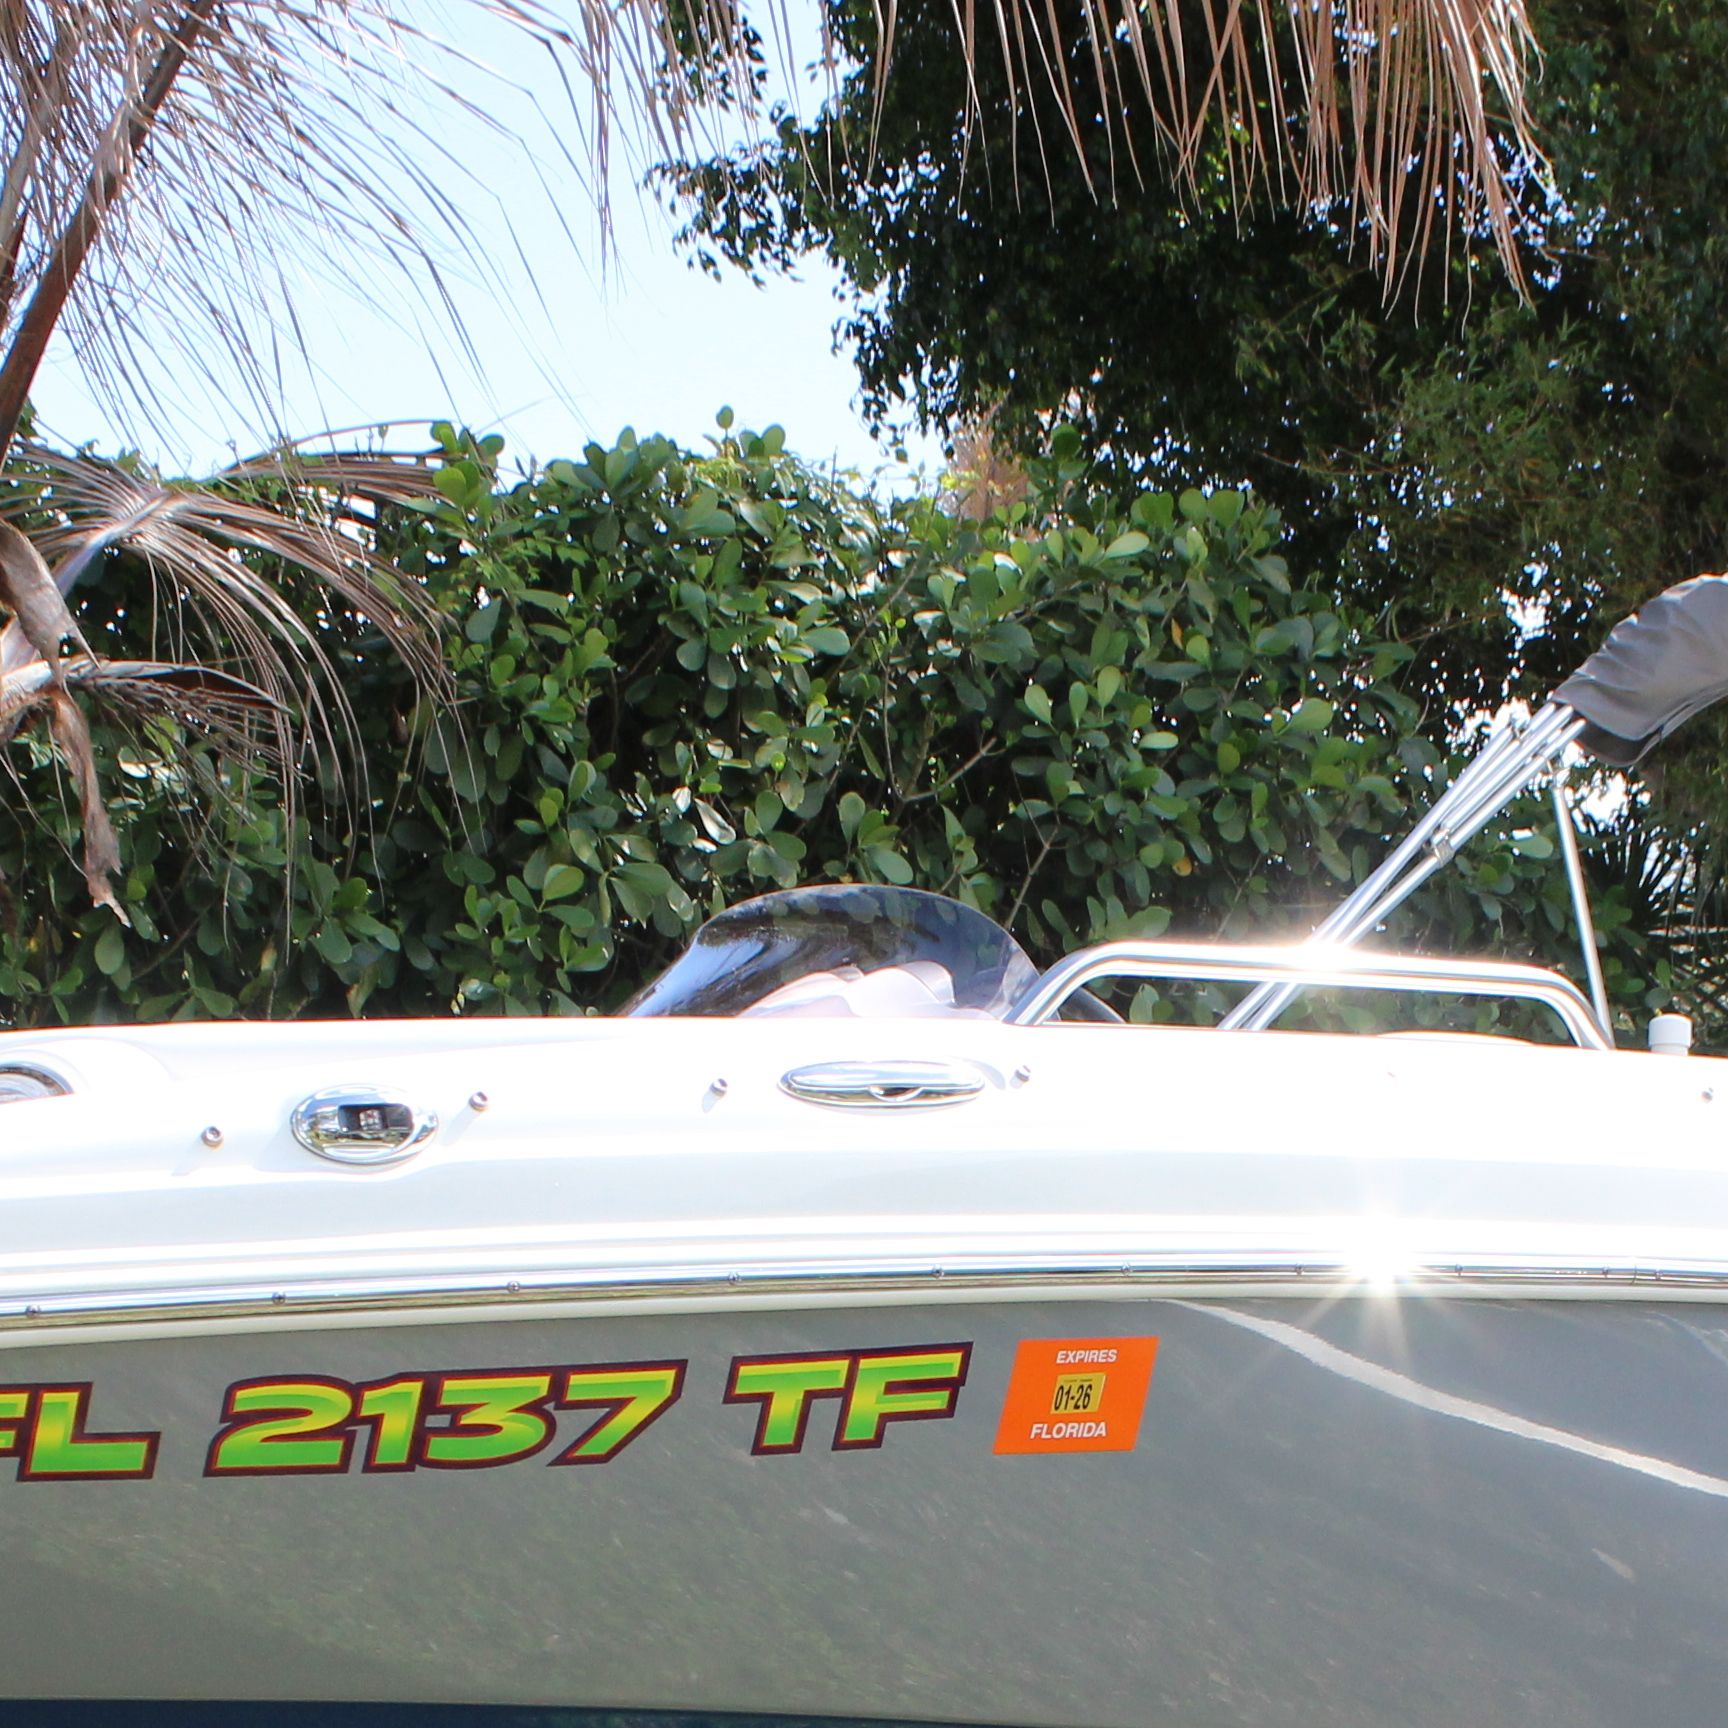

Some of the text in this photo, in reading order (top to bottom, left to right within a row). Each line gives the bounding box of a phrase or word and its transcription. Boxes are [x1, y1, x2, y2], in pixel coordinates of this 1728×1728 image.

[1056, 1349, 1118, 1364] EXPIRES
[1054, 1384, 1093, 1411] 01-26
[203, 1358, 689, 1479] 2137
[722, 1341, 974, 1456] TF
[1030, 1421, 1107, 1440] FLORIDA
